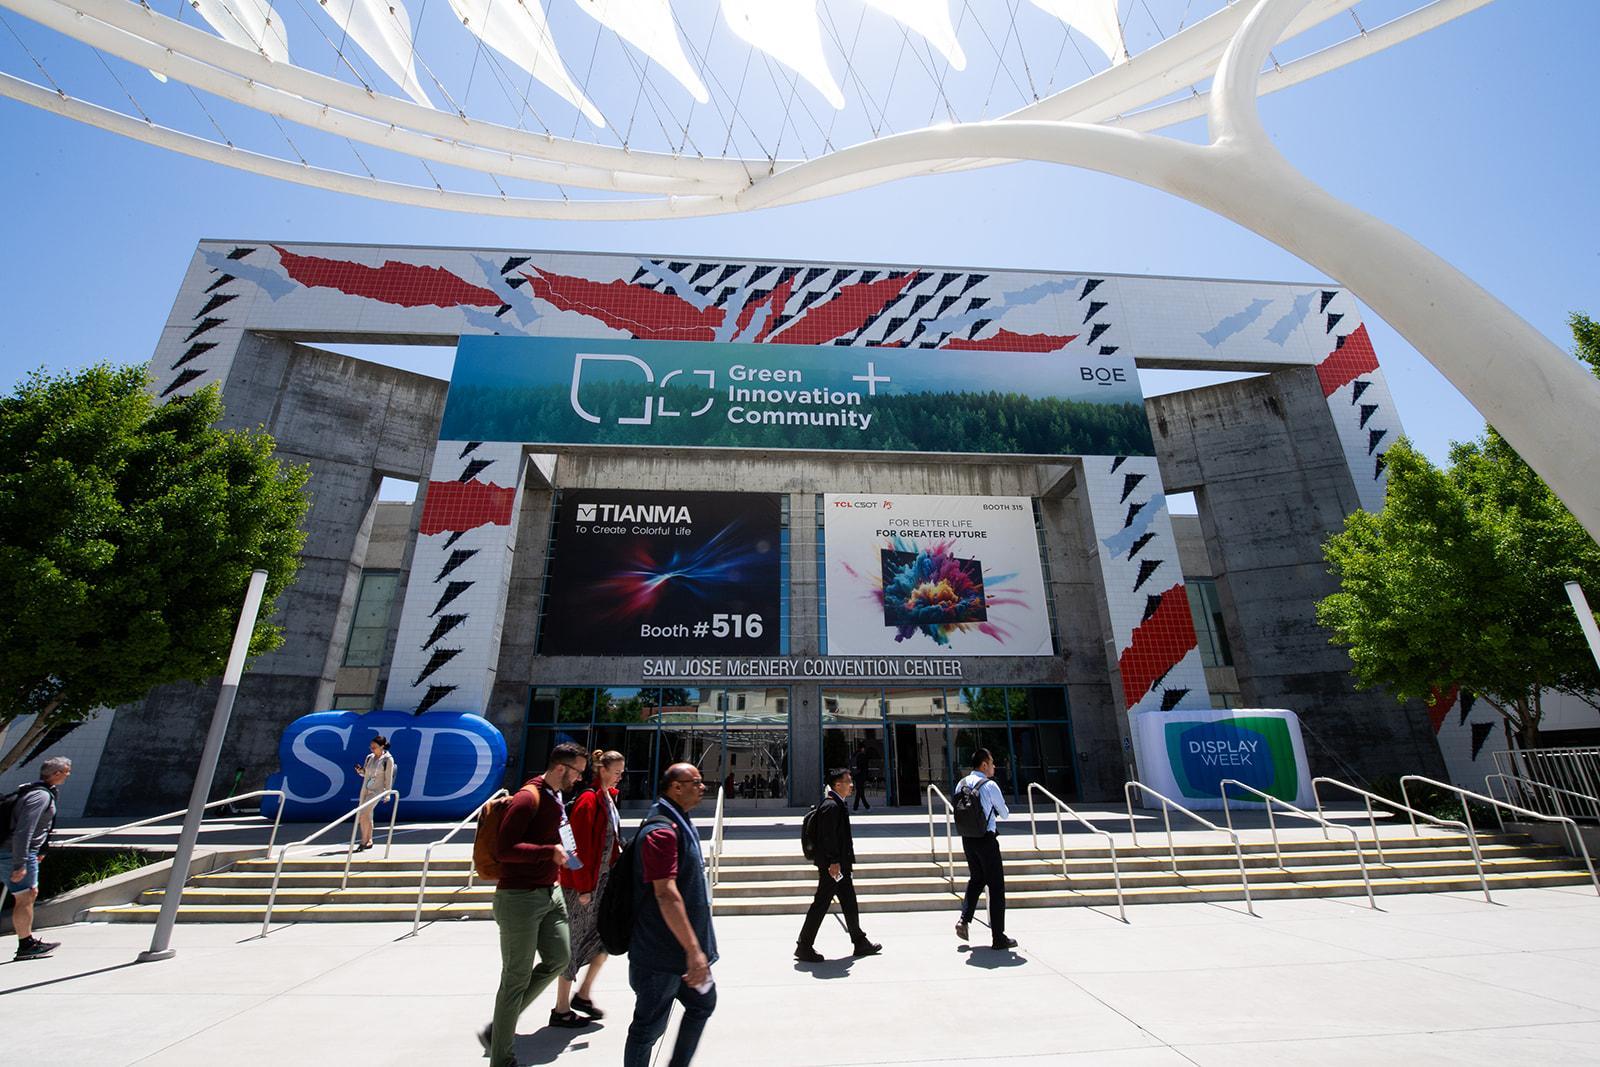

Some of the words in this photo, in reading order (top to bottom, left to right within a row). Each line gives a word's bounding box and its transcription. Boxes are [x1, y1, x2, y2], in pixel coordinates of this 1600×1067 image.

[728, 365, 802, 383] Green
[1080, 366, 1126, 385] BOE
[728, 385, 861, 405] Innovation
[727, 407, 872, 430] Community
[854, 501, 878, 509] CSOT
[600, 504, 692, 524] TIANMA
[576, 525, 587, 534] To
[592, 525, 627, 535] Create
[632, 526, 670, 536] Colorful
[675, 527, 692, 536] Life
[889, 519, 910, 527] FOR
[912, 519, 950, 528] BETTER
[952, 520, 973, 528] LIFE
[876, 529, 897, 538] FOR
[900, 530, 946, 538] GREATER
[949, 531, 988, 539] FUTURE
[640, 624, 689, 638] Booth
[643, 659, 676, 676] SAN
[680, 659, 722, 676] JOSE
[727, 660, 799, 676] McENERY
[803, 659, 899, 676] CONVENTION
[904, 659, 962, 676] CENTER
[1189, 740, 1258, 753] DISPLAY
[1201, 753, 1253, 766] WEEK
